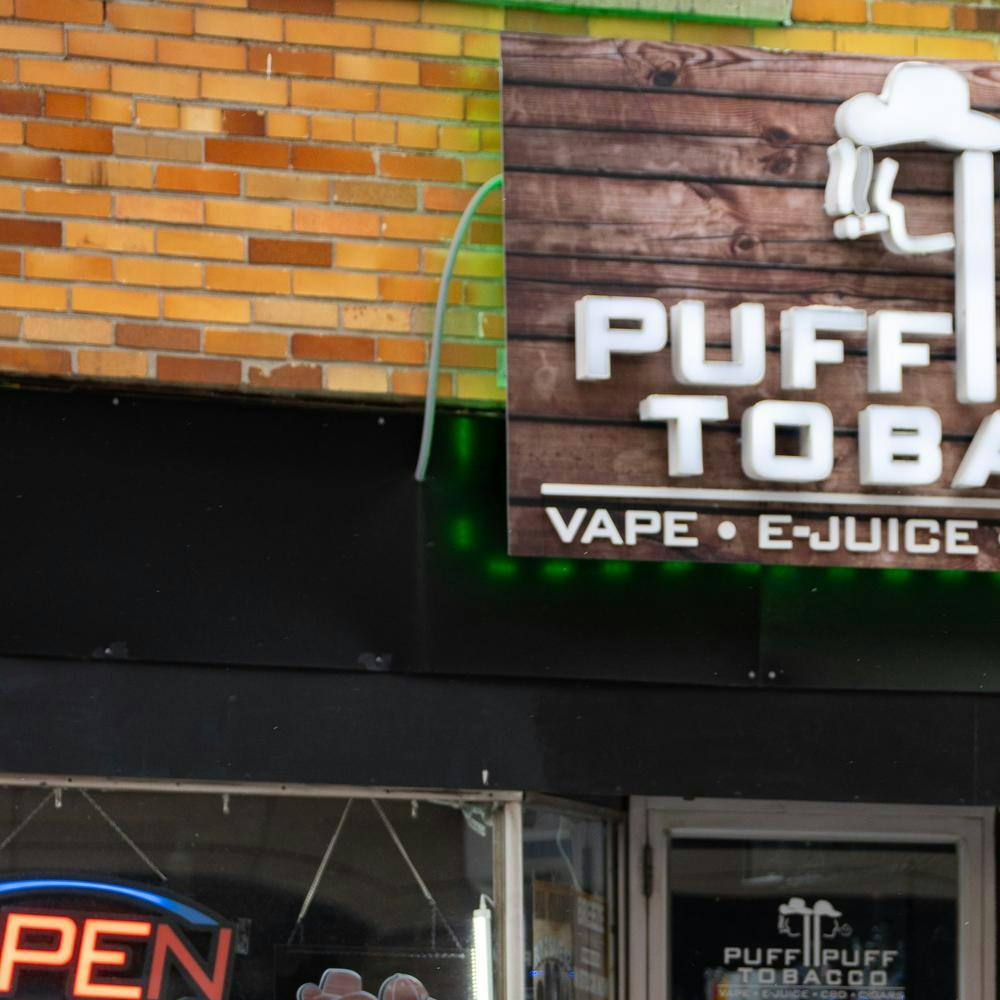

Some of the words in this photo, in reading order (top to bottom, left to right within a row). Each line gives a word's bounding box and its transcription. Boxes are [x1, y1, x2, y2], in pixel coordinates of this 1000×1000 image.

[574, 294, 954, 393] PUFF
[546, 507, 699, 548] VAPE
[757, 513, 979, 556] E-JUICE
[723, 947, 801, 965] PUFF
[822, 949, 899, 967] PUFF
[737, 967, 889, 986] TOBACCO
